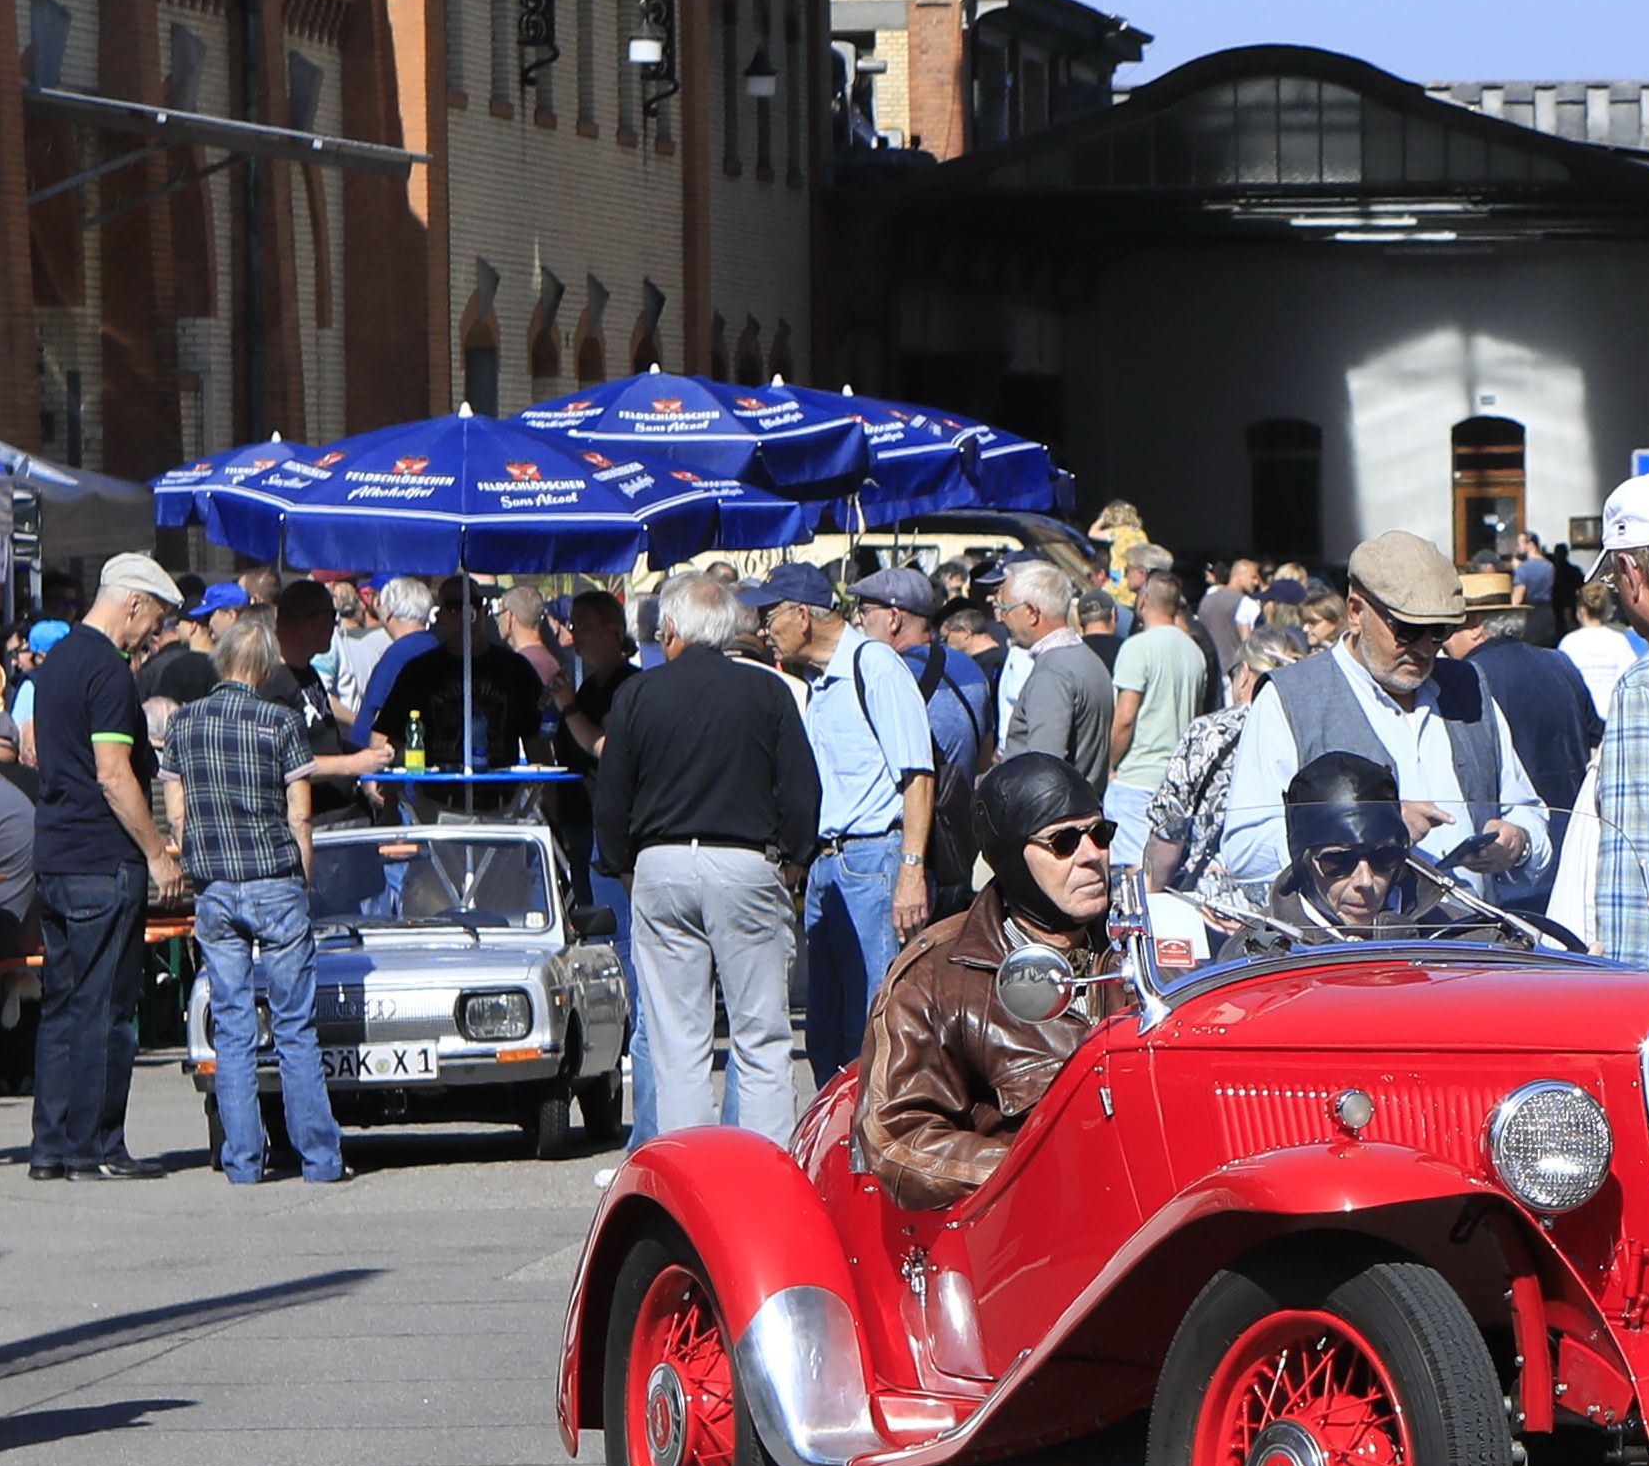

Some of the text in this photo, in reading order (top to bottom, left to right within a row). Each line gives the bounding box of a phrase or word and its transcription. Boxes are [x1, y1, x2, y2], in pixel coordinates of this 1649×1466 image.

[500, 492, 579, 509] Sans Alcool
[321, 1047, 434, 1078] SÄK X 1
